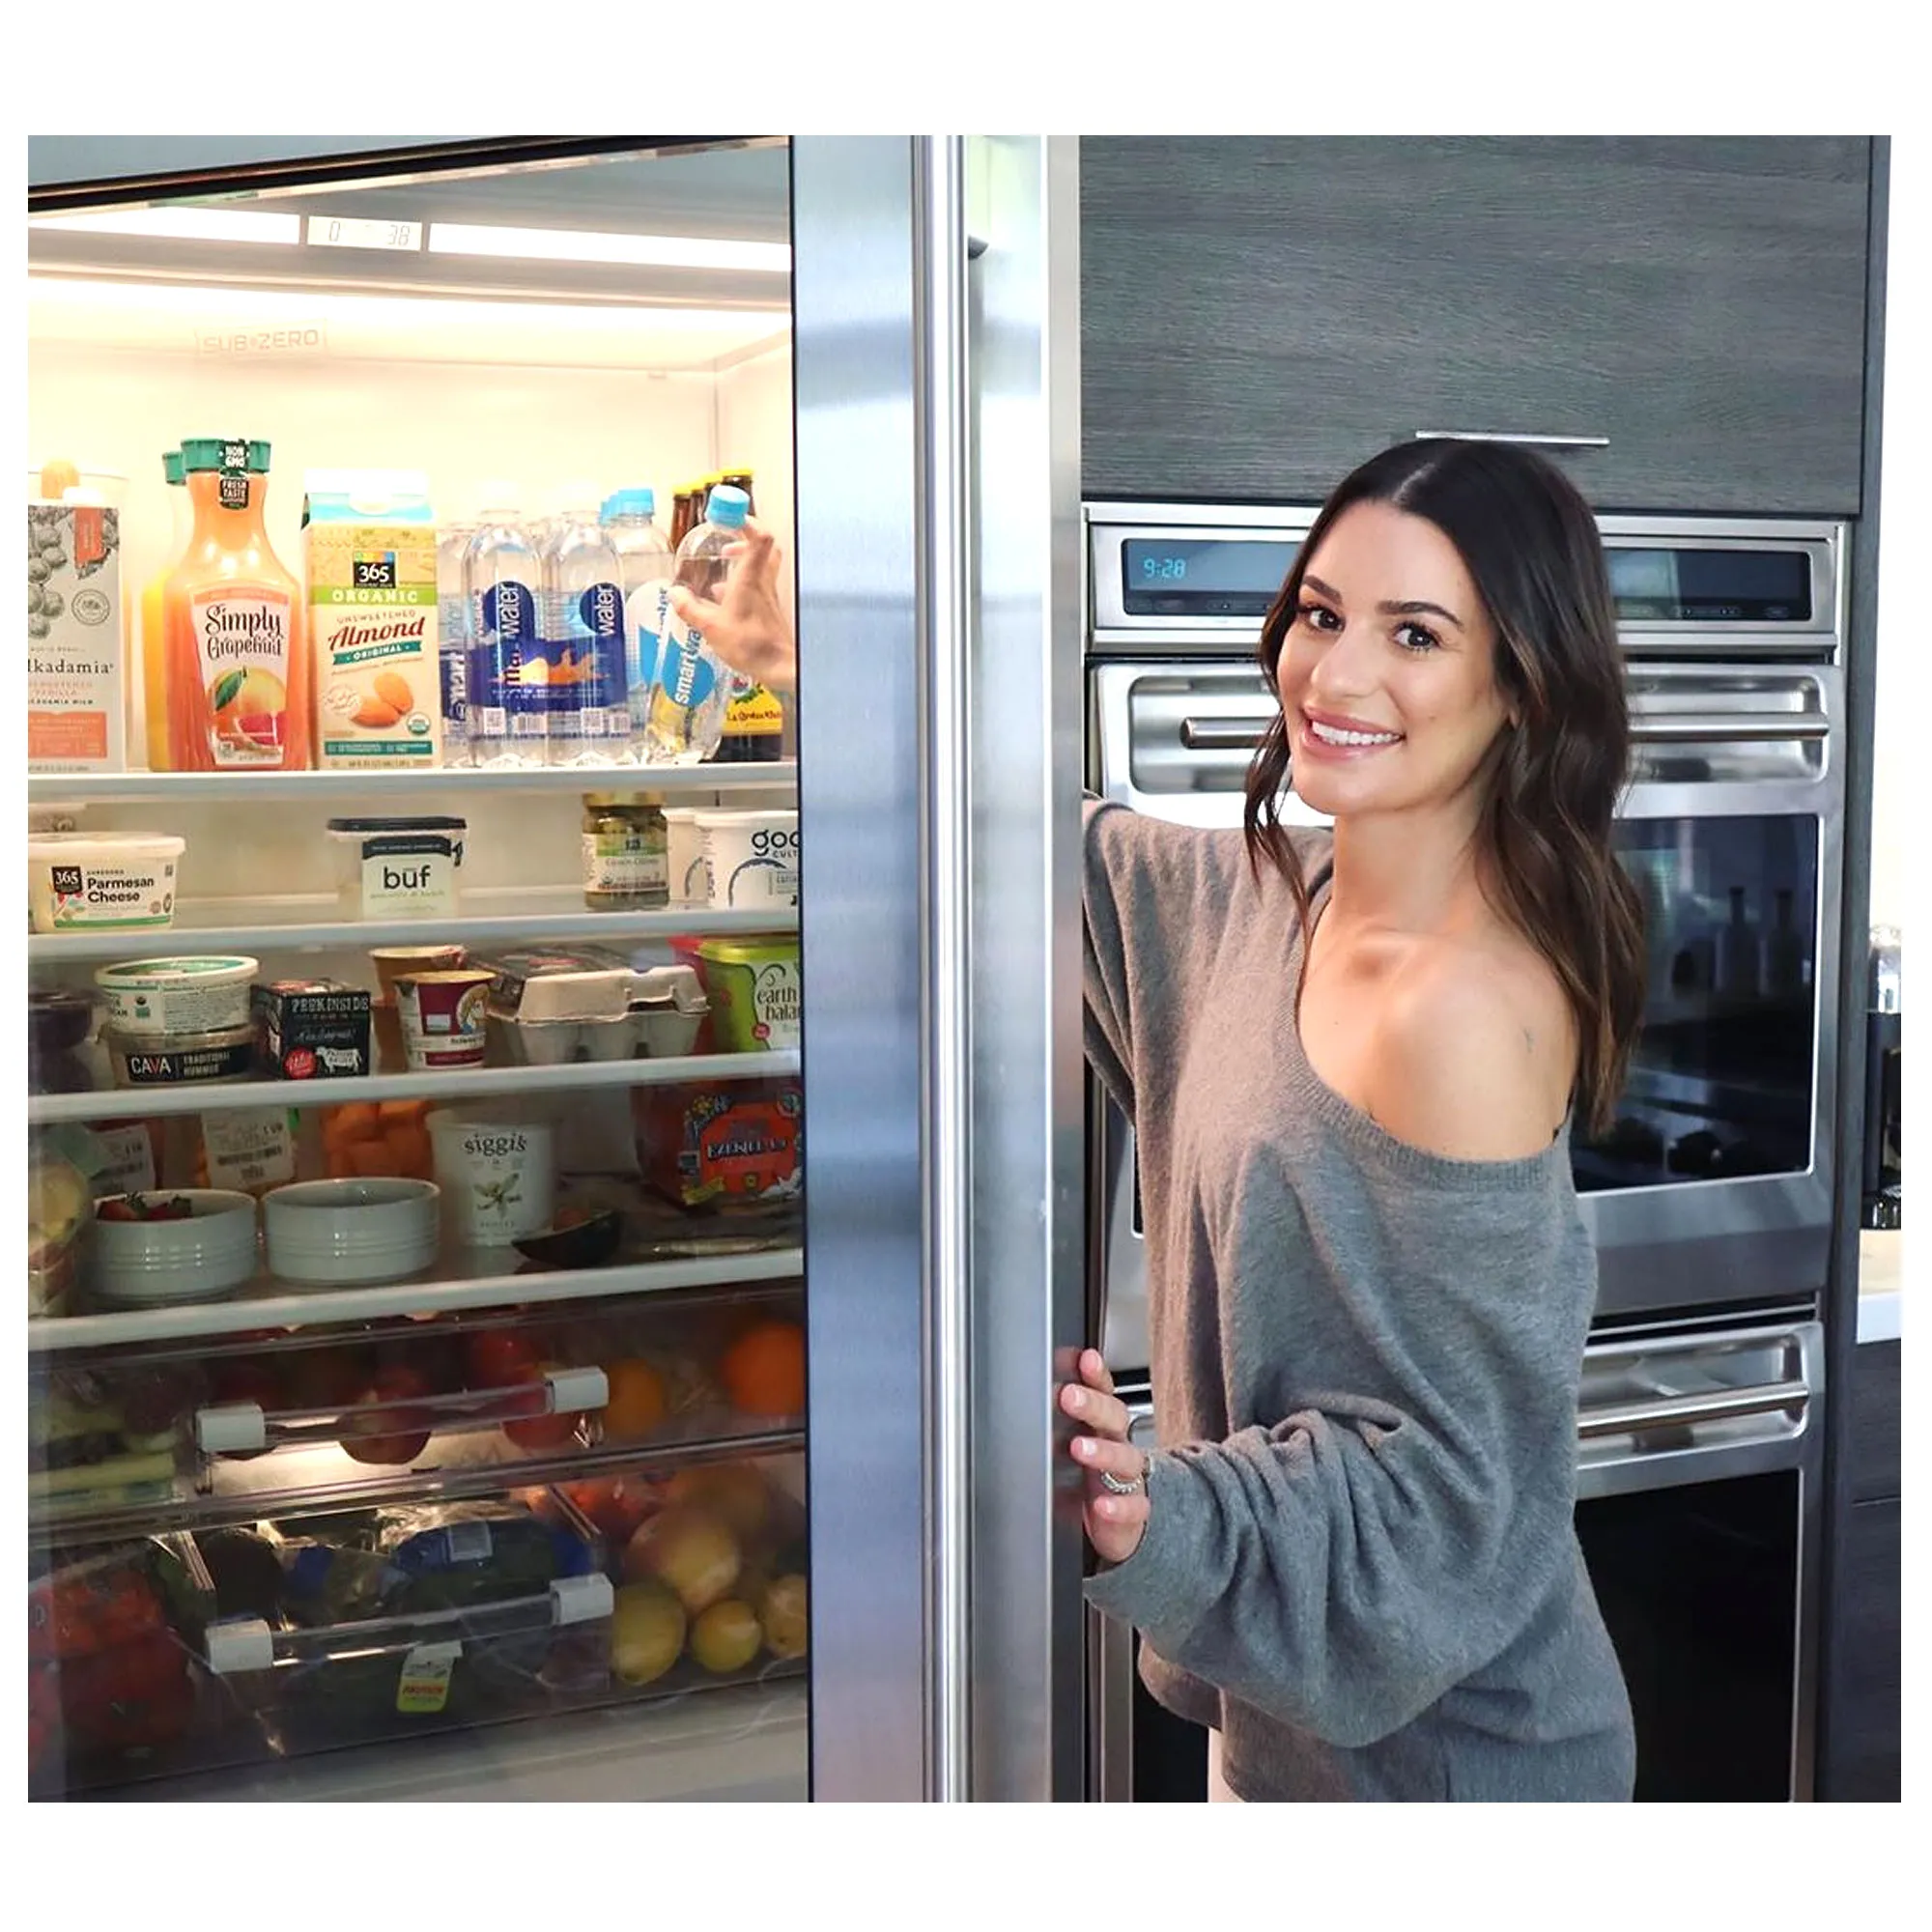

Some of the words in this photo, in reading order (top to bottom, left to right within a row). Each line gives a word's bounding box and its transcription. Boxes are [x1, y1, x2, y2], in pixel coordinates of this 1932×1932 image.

[358, 563, 390, 583] 365
[1143, 557, 1186, 579] 9:28
[331, 589, 418, 604] ORGANIC
[500, 582, 522, 639] water
[593, 583, 615, 638] water
[205, 603, 284, 639] Simply
[327, 615, 426, 652] Almond
[207, 635, 281, 661] Grapefruit
[353, 643, 403, 662] ORIGINAL
[56, 870, 78, 885] 365
[88, 877, 155, 890] Parmesan
[88, 891, 140, 903] Cheese
[757, 985, 797, 1005] earth
[130, 1056, 172, 1075] CAVA
